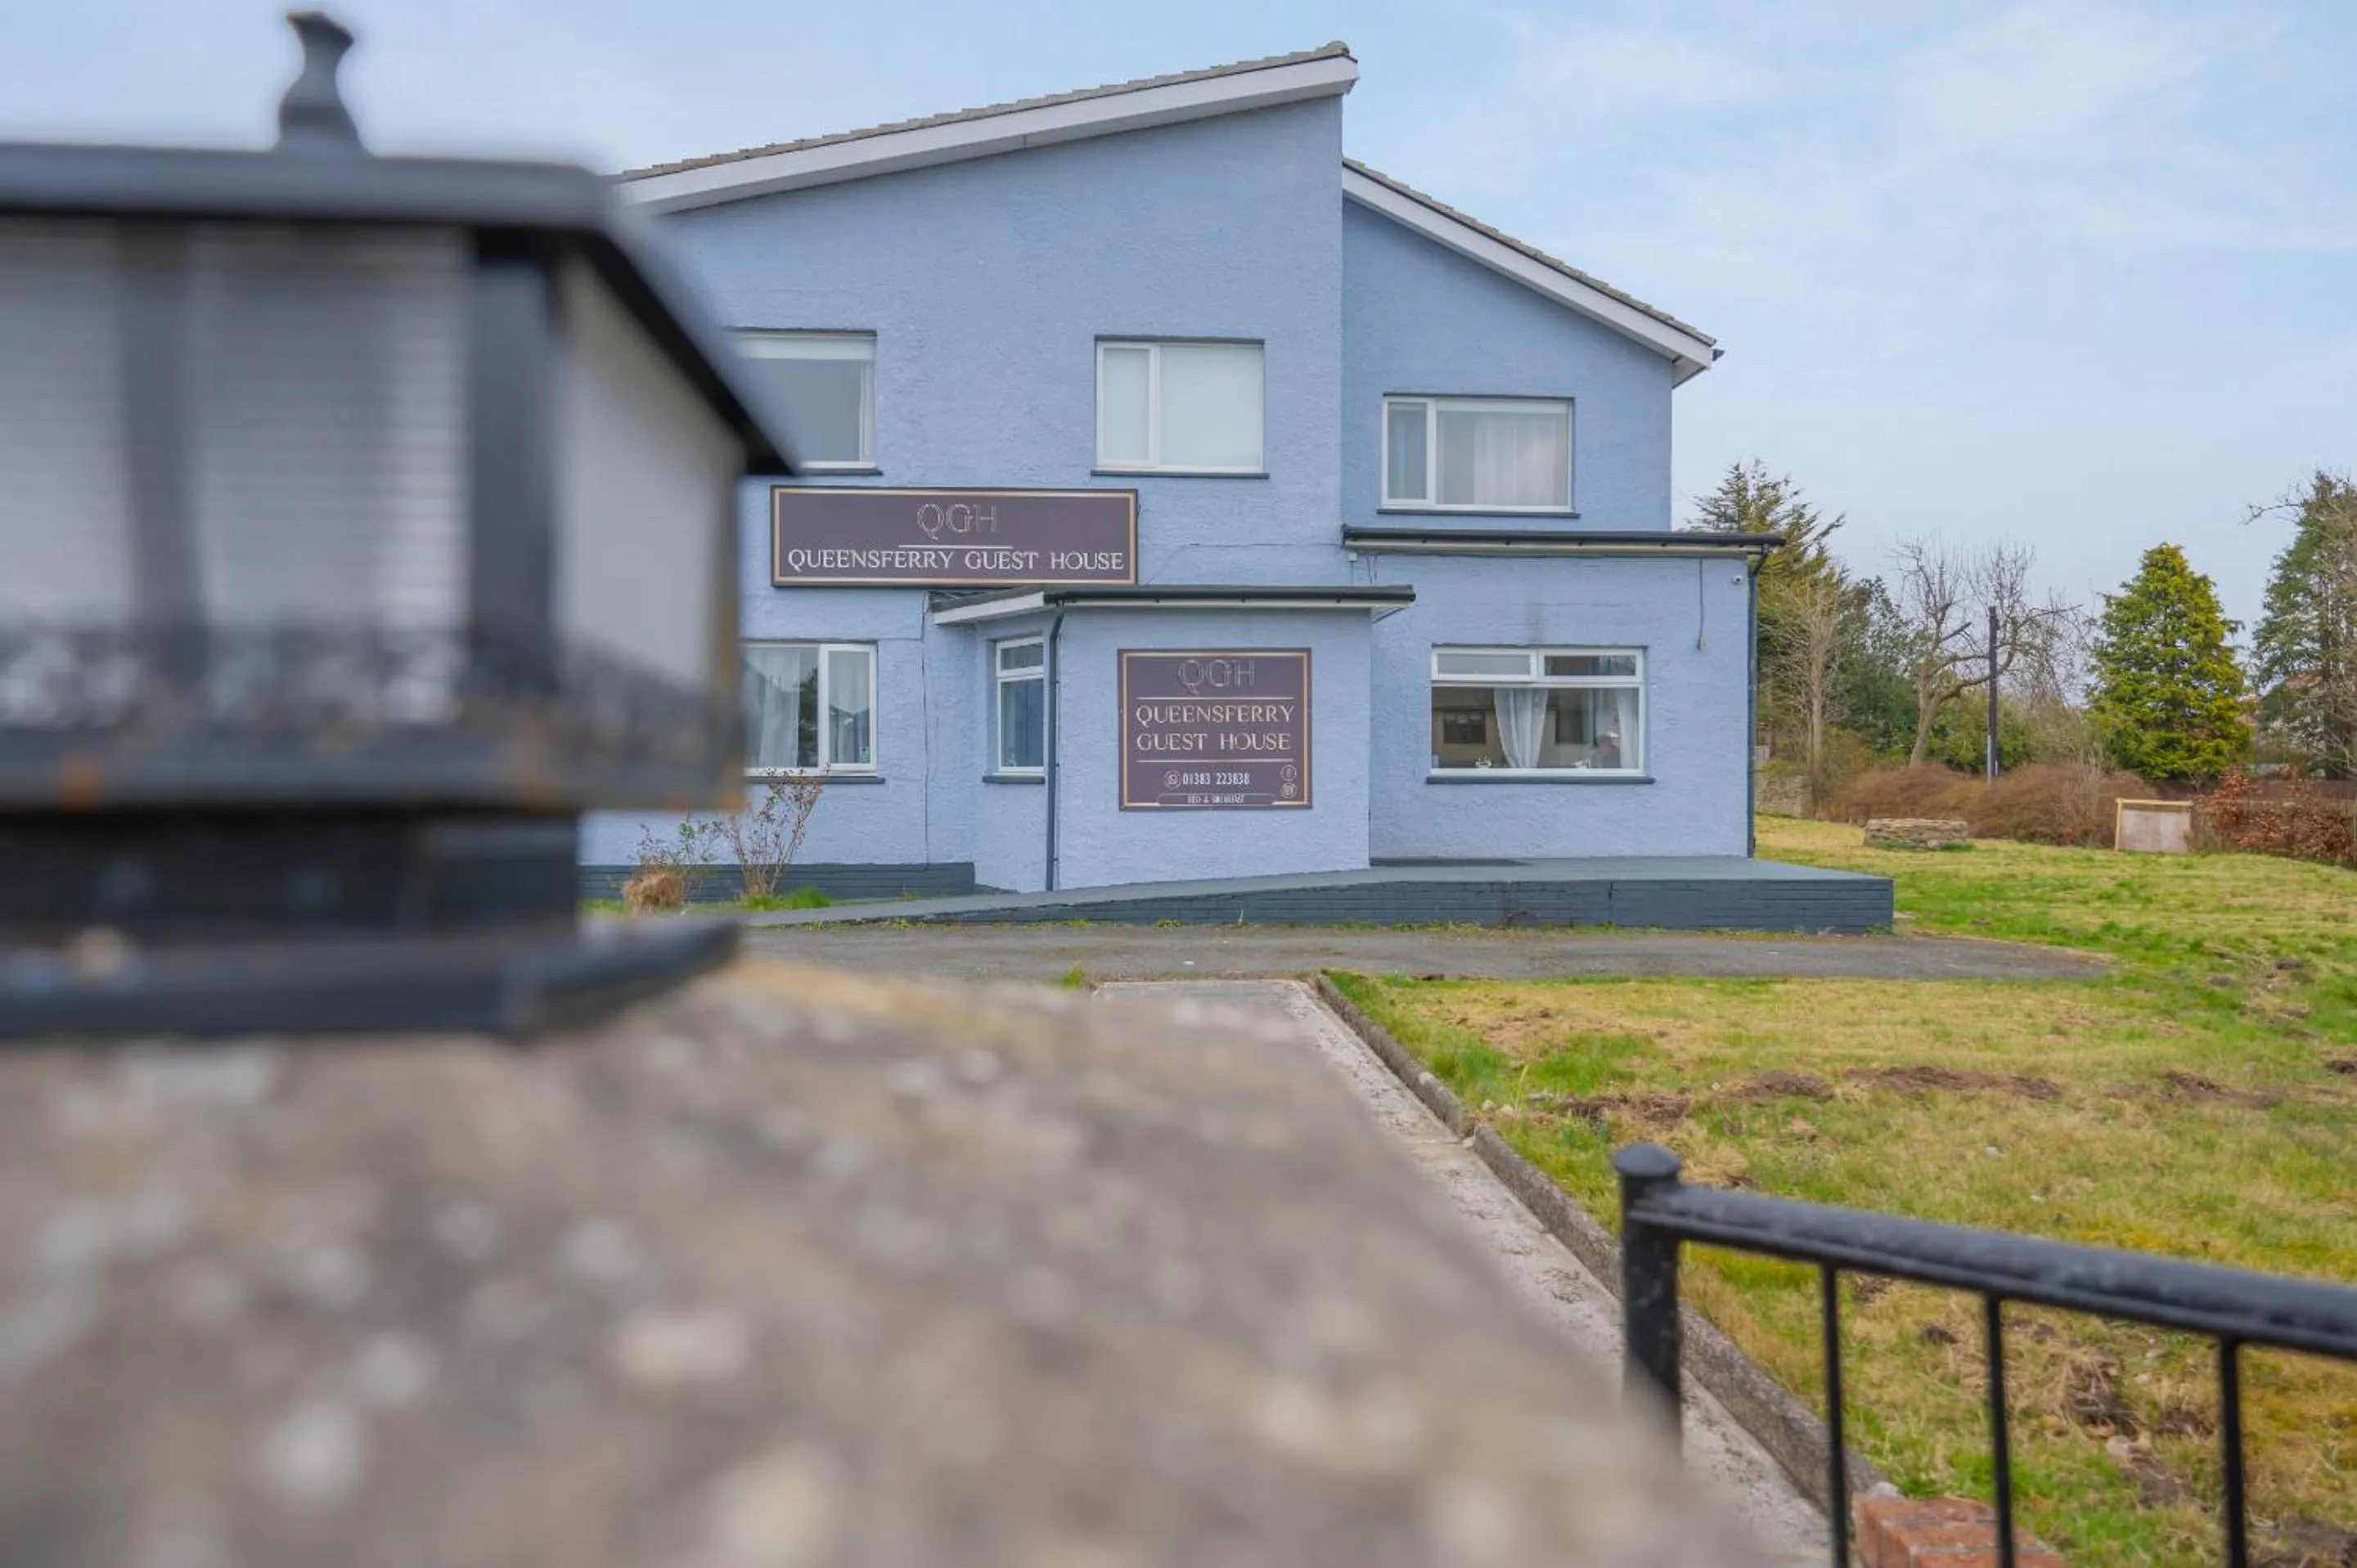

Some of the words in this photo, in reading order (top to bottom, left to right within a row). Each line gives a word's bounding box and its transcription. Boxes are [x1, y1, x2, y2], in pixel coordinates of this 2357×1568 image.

[916, 503, 999, 539] QGH
[788, 549, 955, 572] QUEENSFERRY
[964, 550, 1039, 571] GUEST
[1050, 551, 1125, 570] HOUSE
[1178, 658, 1256, 695] QGH
[1136, 704, 1294, 728] QUEENSFERRY
[1136, 733, 1208, 751] GUEST
[1220, 732, 1291, 751] HOUSE
[1182, 772, 1212, 785] 01383
[1216, 772, 1250, 785] 223838
